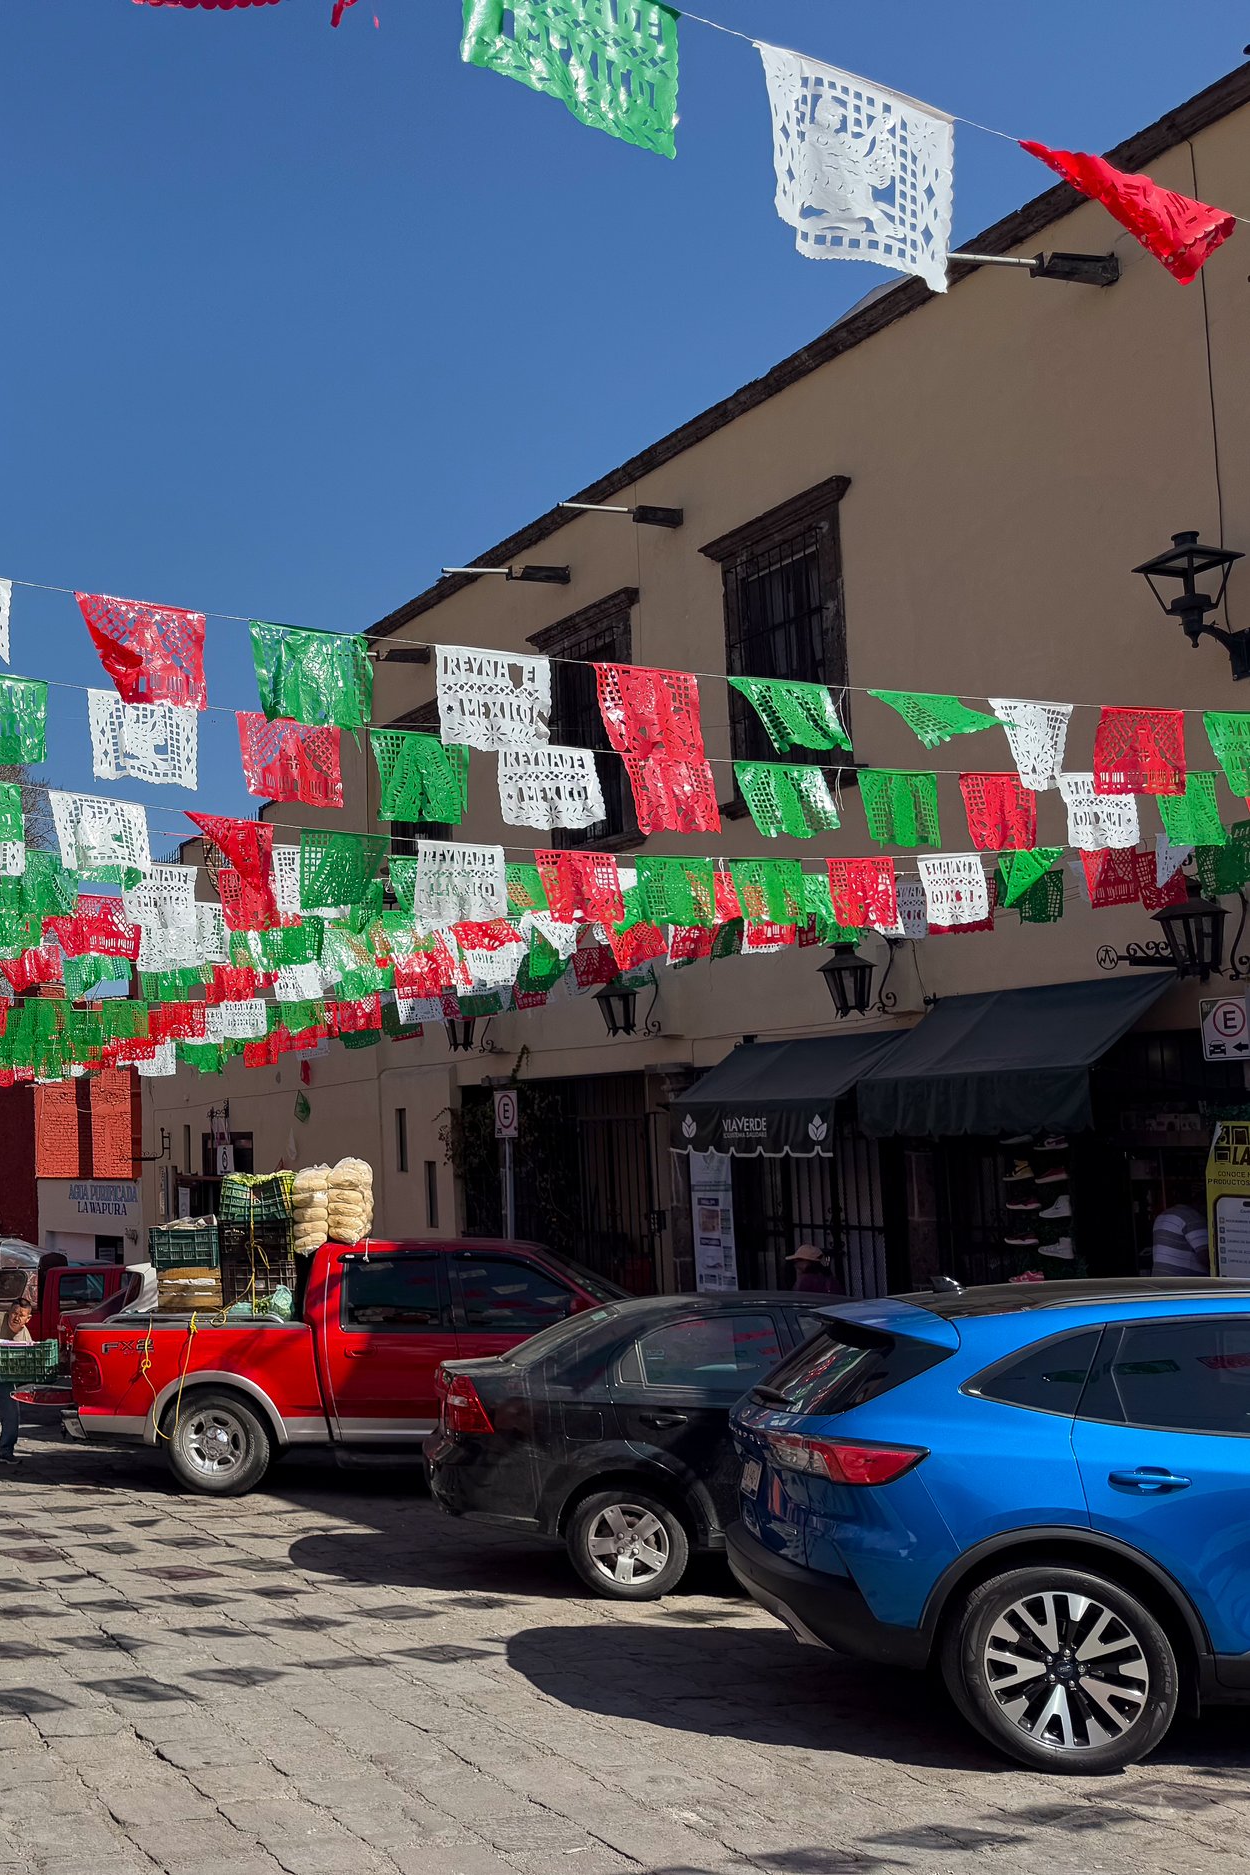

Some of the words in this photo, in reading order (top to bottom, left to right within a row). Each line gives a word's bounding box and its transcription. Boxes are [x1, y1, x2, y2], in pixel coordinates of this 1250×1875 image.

[444, 655, 508, 678] REYNA
[460, 698, 535, 727] MEXICO
[504, 751, 562, 768] REYNA
[563, 756, 586, 770] DE
[518, 786, 589, 804] MEXICO
[424, 850, 477, 865] REYNA
[478, 852, 495, 866] DE
[1223, 1011, 1237, 1029] E
[503, 1103, 510, 1119] E
[69, 1184, 89, 1201] AGUA
[90, 1185, 138, 1203] PURIFICADA
